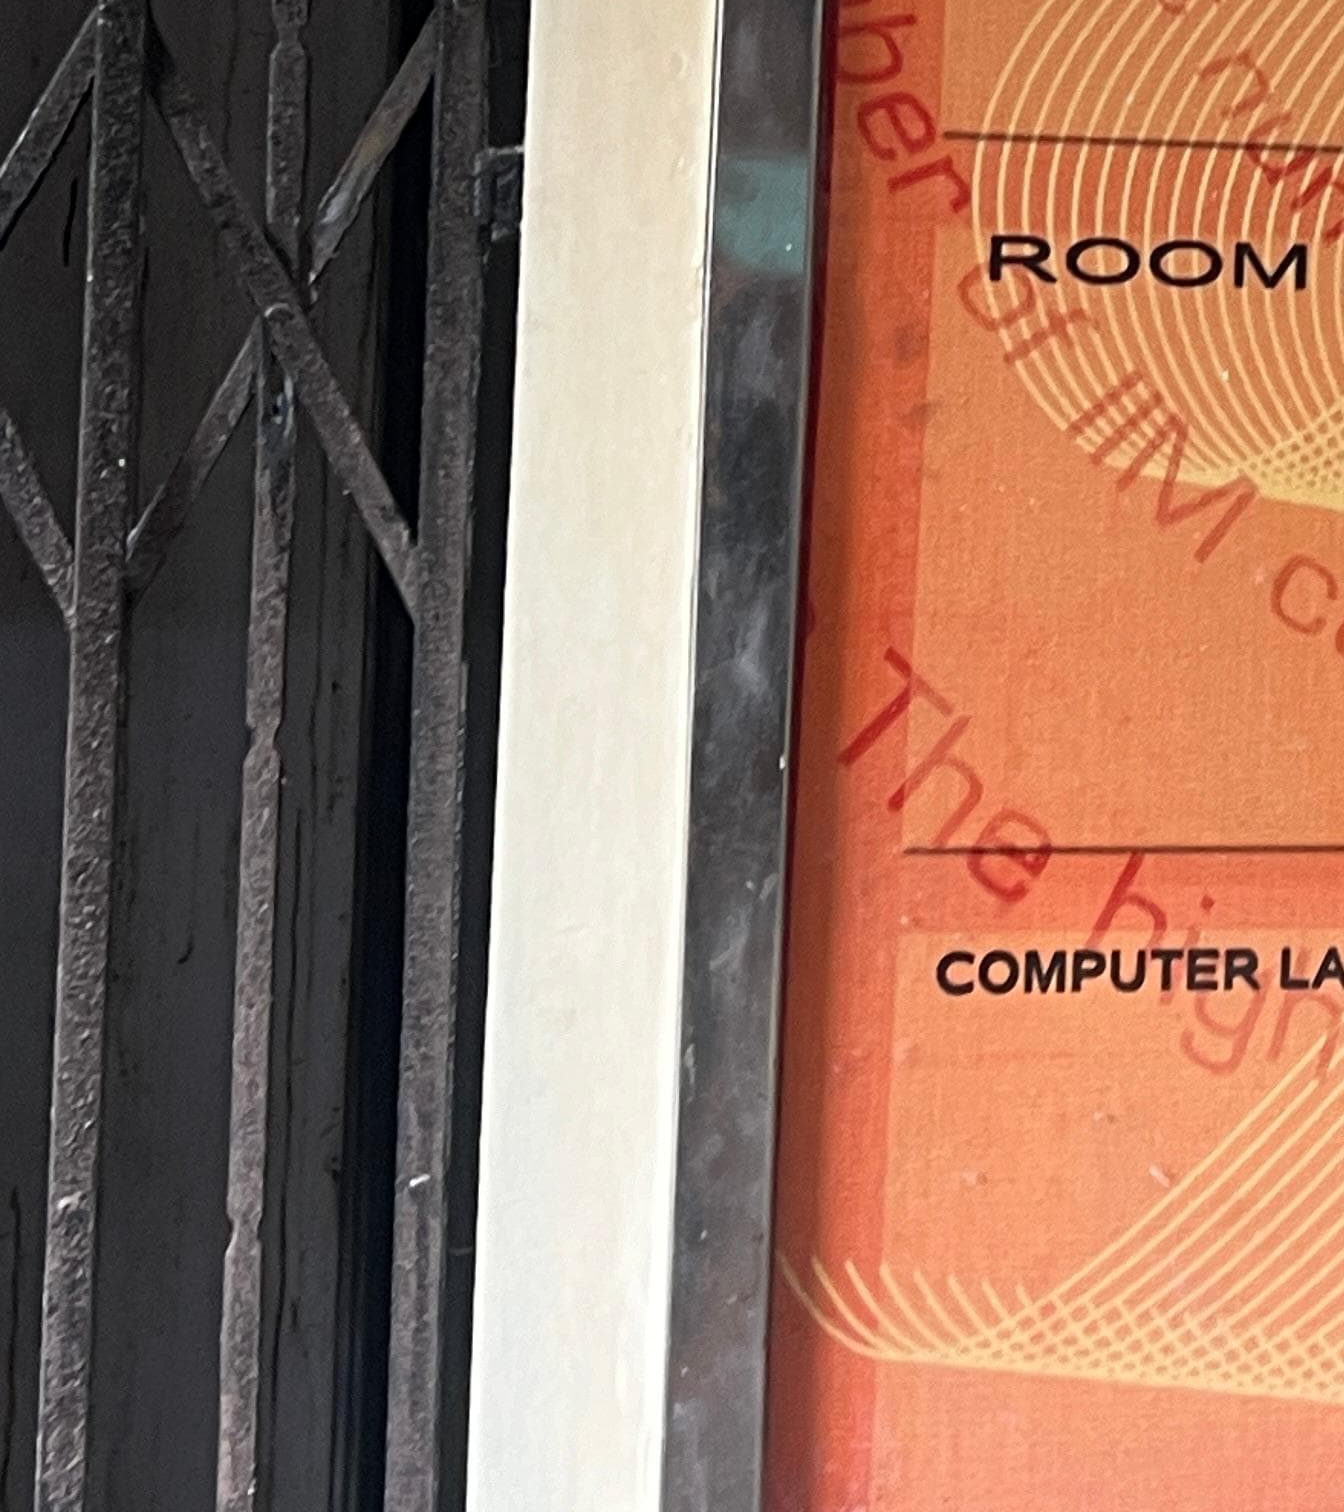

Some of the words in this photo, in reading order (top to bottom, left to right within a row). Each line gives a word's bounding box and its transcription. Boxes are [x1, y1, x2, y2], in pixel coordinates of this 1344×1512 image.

[987, 234, 1307, 292] ROOM
[836, 645, 1053, 905] The
[935, 946, 1261, 996] COMPUTER
